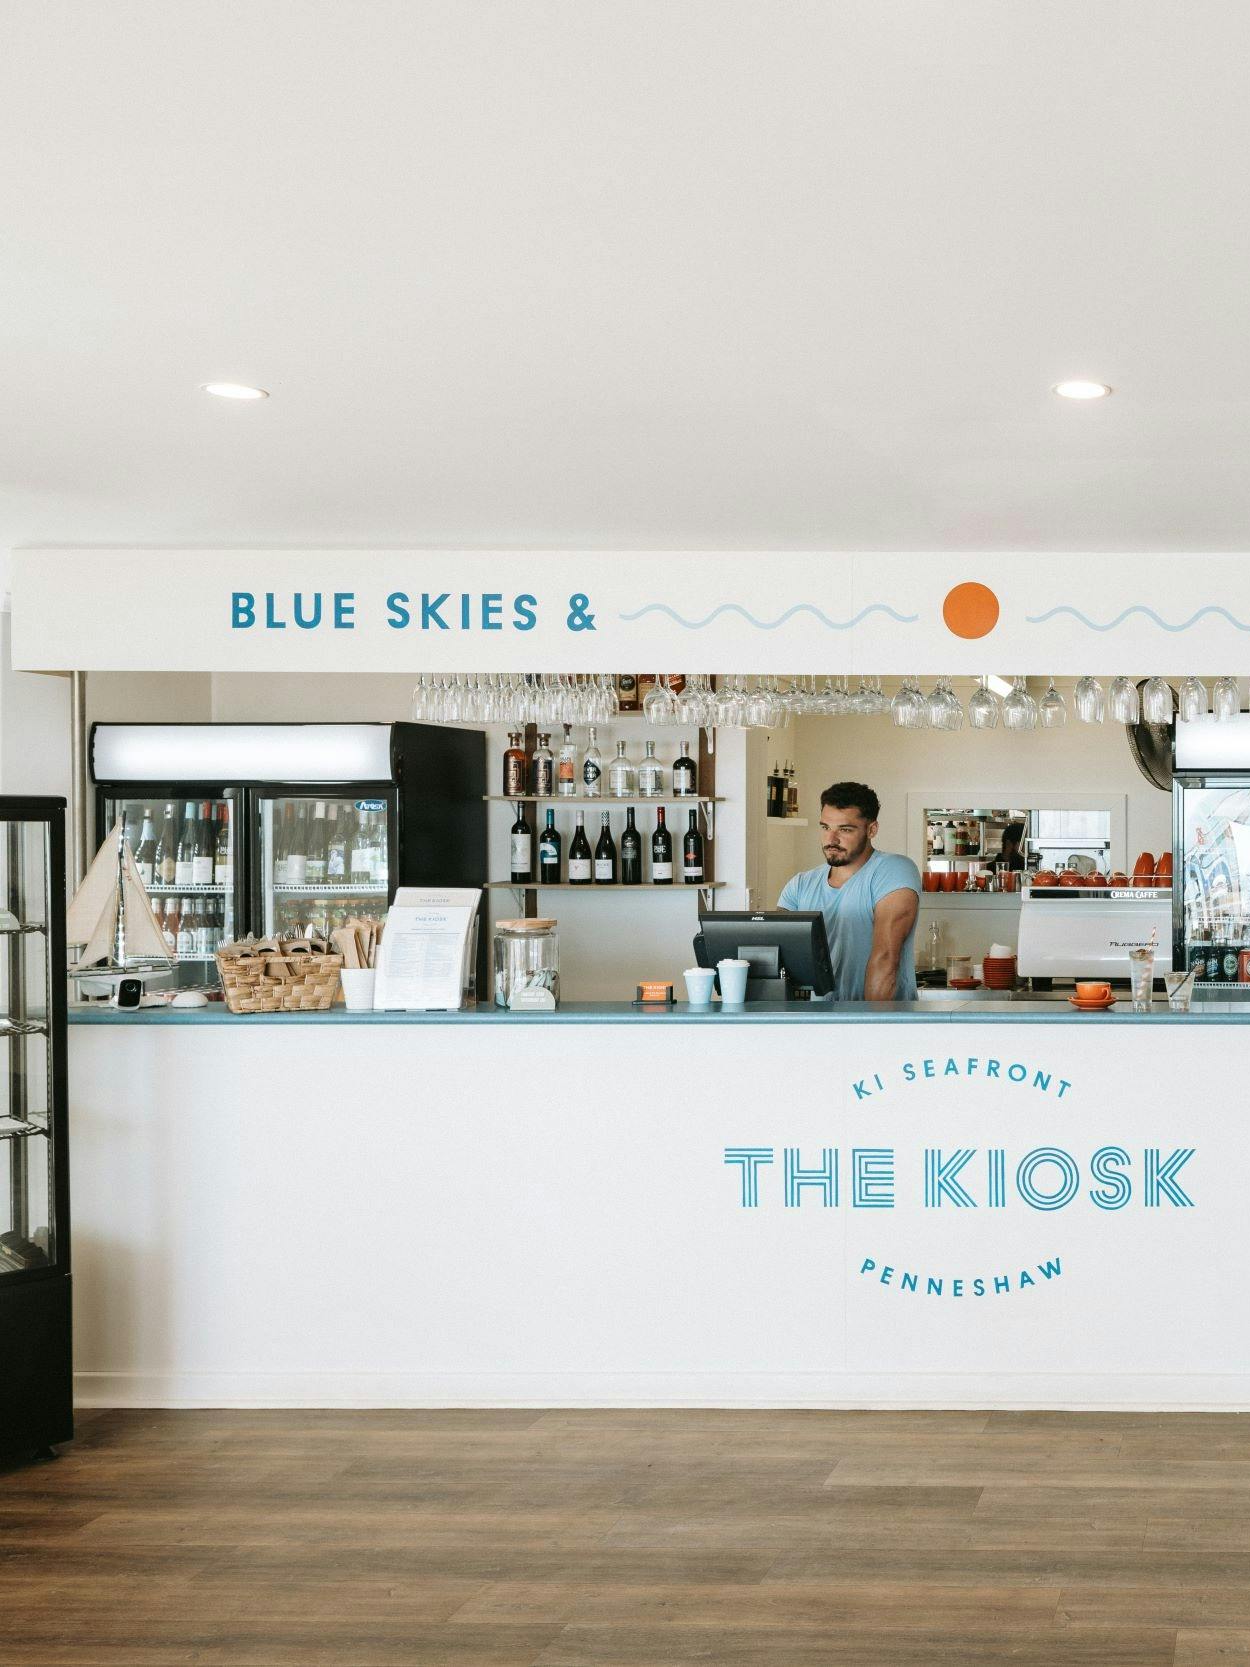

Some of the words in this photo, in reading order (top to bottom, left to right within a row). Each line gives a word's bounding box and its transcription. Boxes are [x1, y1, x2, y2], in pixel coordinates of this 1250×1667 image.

[231, 591, 356, 630] BLUE
[386, 591, 538, 632] SKIES
[566, 592, 595, 633] &
[852, 1073, 884, 1100] KI
[902, 1056, 1072, 1099] SEAFRONT
[724, 1147, 895, 1209] THE
[924, 1146, 1196, 1212] KIOSK
[860, 1257, 1063, 1297] PENNESHAW
